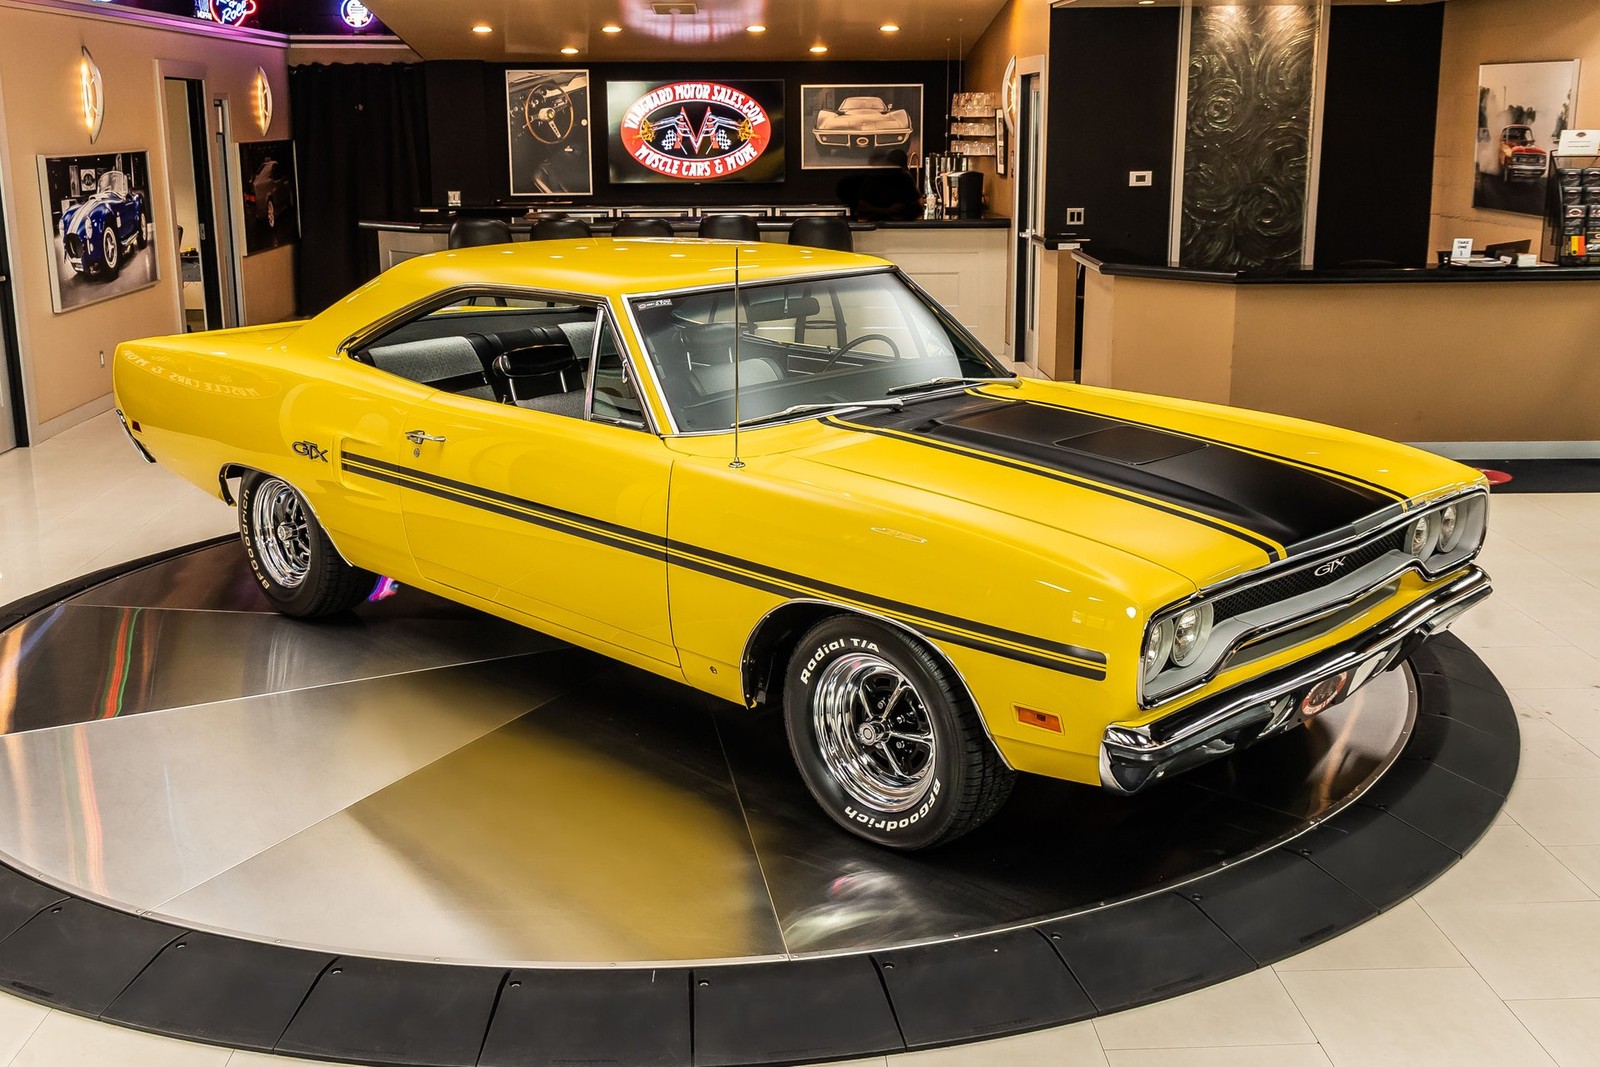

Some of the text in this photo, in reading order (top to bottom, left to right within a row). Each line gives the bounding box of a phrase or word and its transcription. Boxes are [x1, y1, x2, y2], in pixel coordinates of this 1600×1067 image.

[624, 84, 766, 129] VANGUARD MOTOR SALES.COM
[634, 143, 758, 177] MUSCLE CARS & MORE
[291, 440, 329, 463] GTX
[241, 489, 271, 590] BFGoodrich
[1313, 556, 1347, 577] GTX
[800, 638, 845, 685] Radial
[844, 778, 941, 832] BFGoodrich
